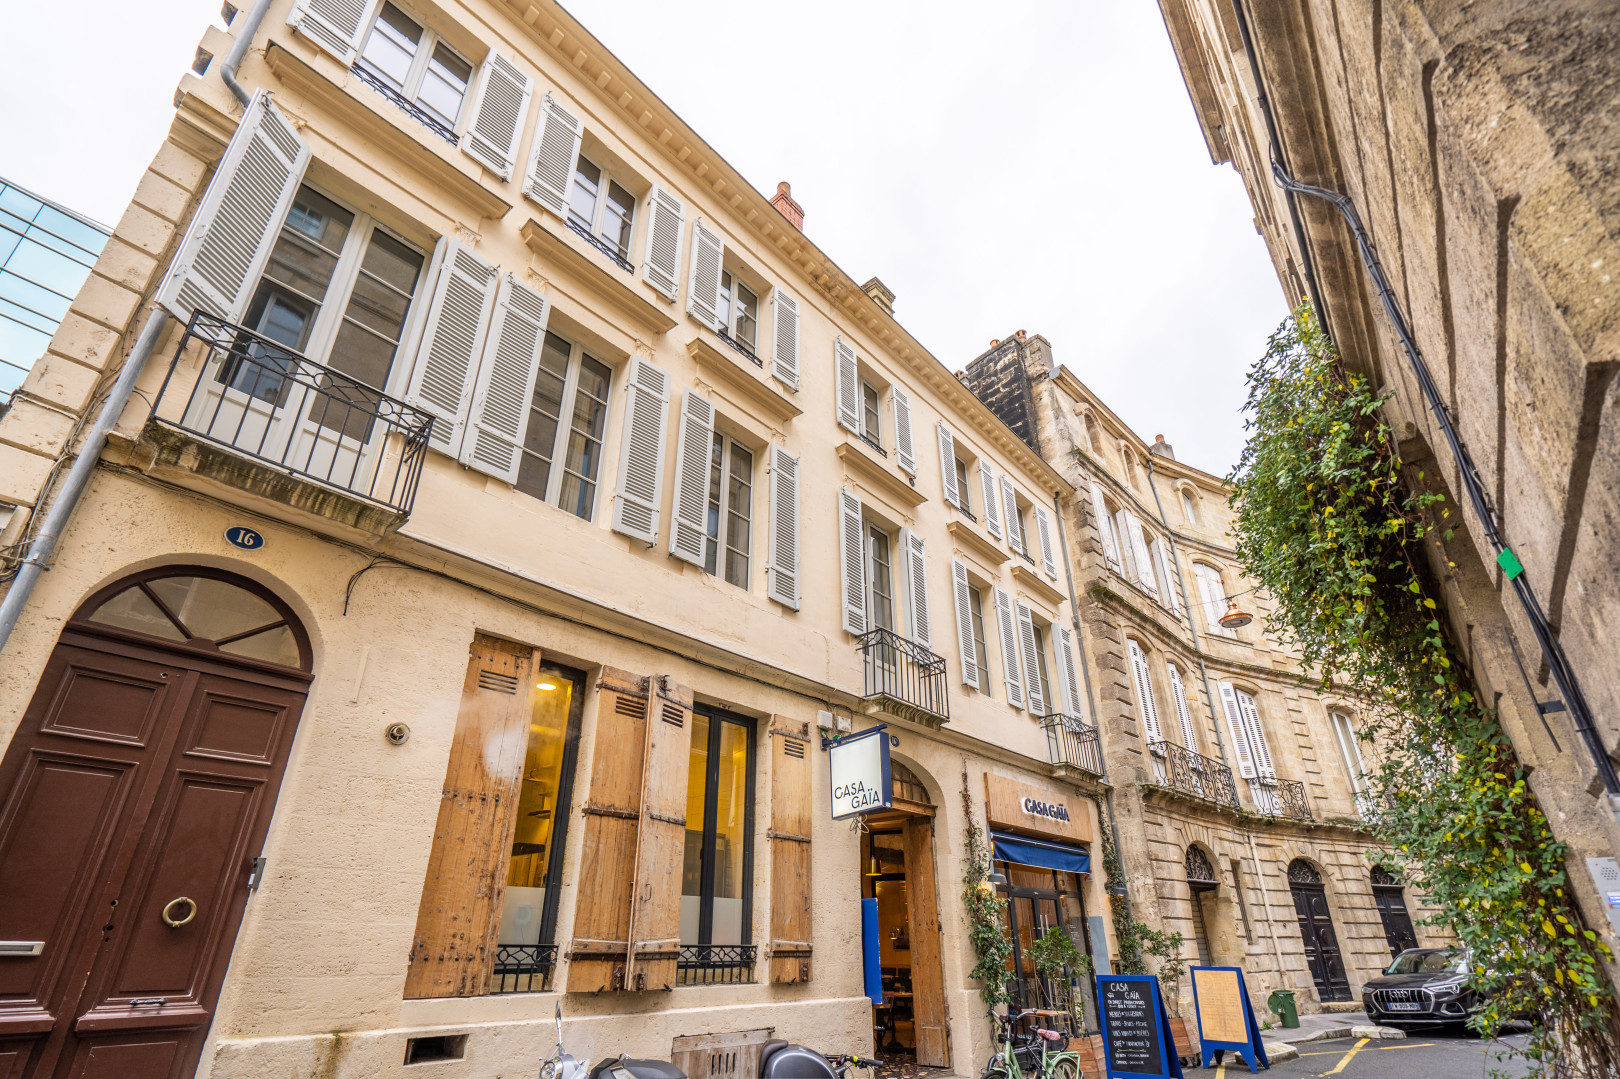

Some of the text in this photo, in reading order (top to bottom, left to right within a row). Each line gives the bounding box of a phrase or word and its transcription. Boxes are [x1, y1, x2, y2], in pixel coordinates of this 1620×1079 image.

[236, 529, 255, 546] 16
[834, 780, 865, 799] CASA
[851, 788, 880, 808] GAÏA
[1110, 982, 1129, 992] CASA
